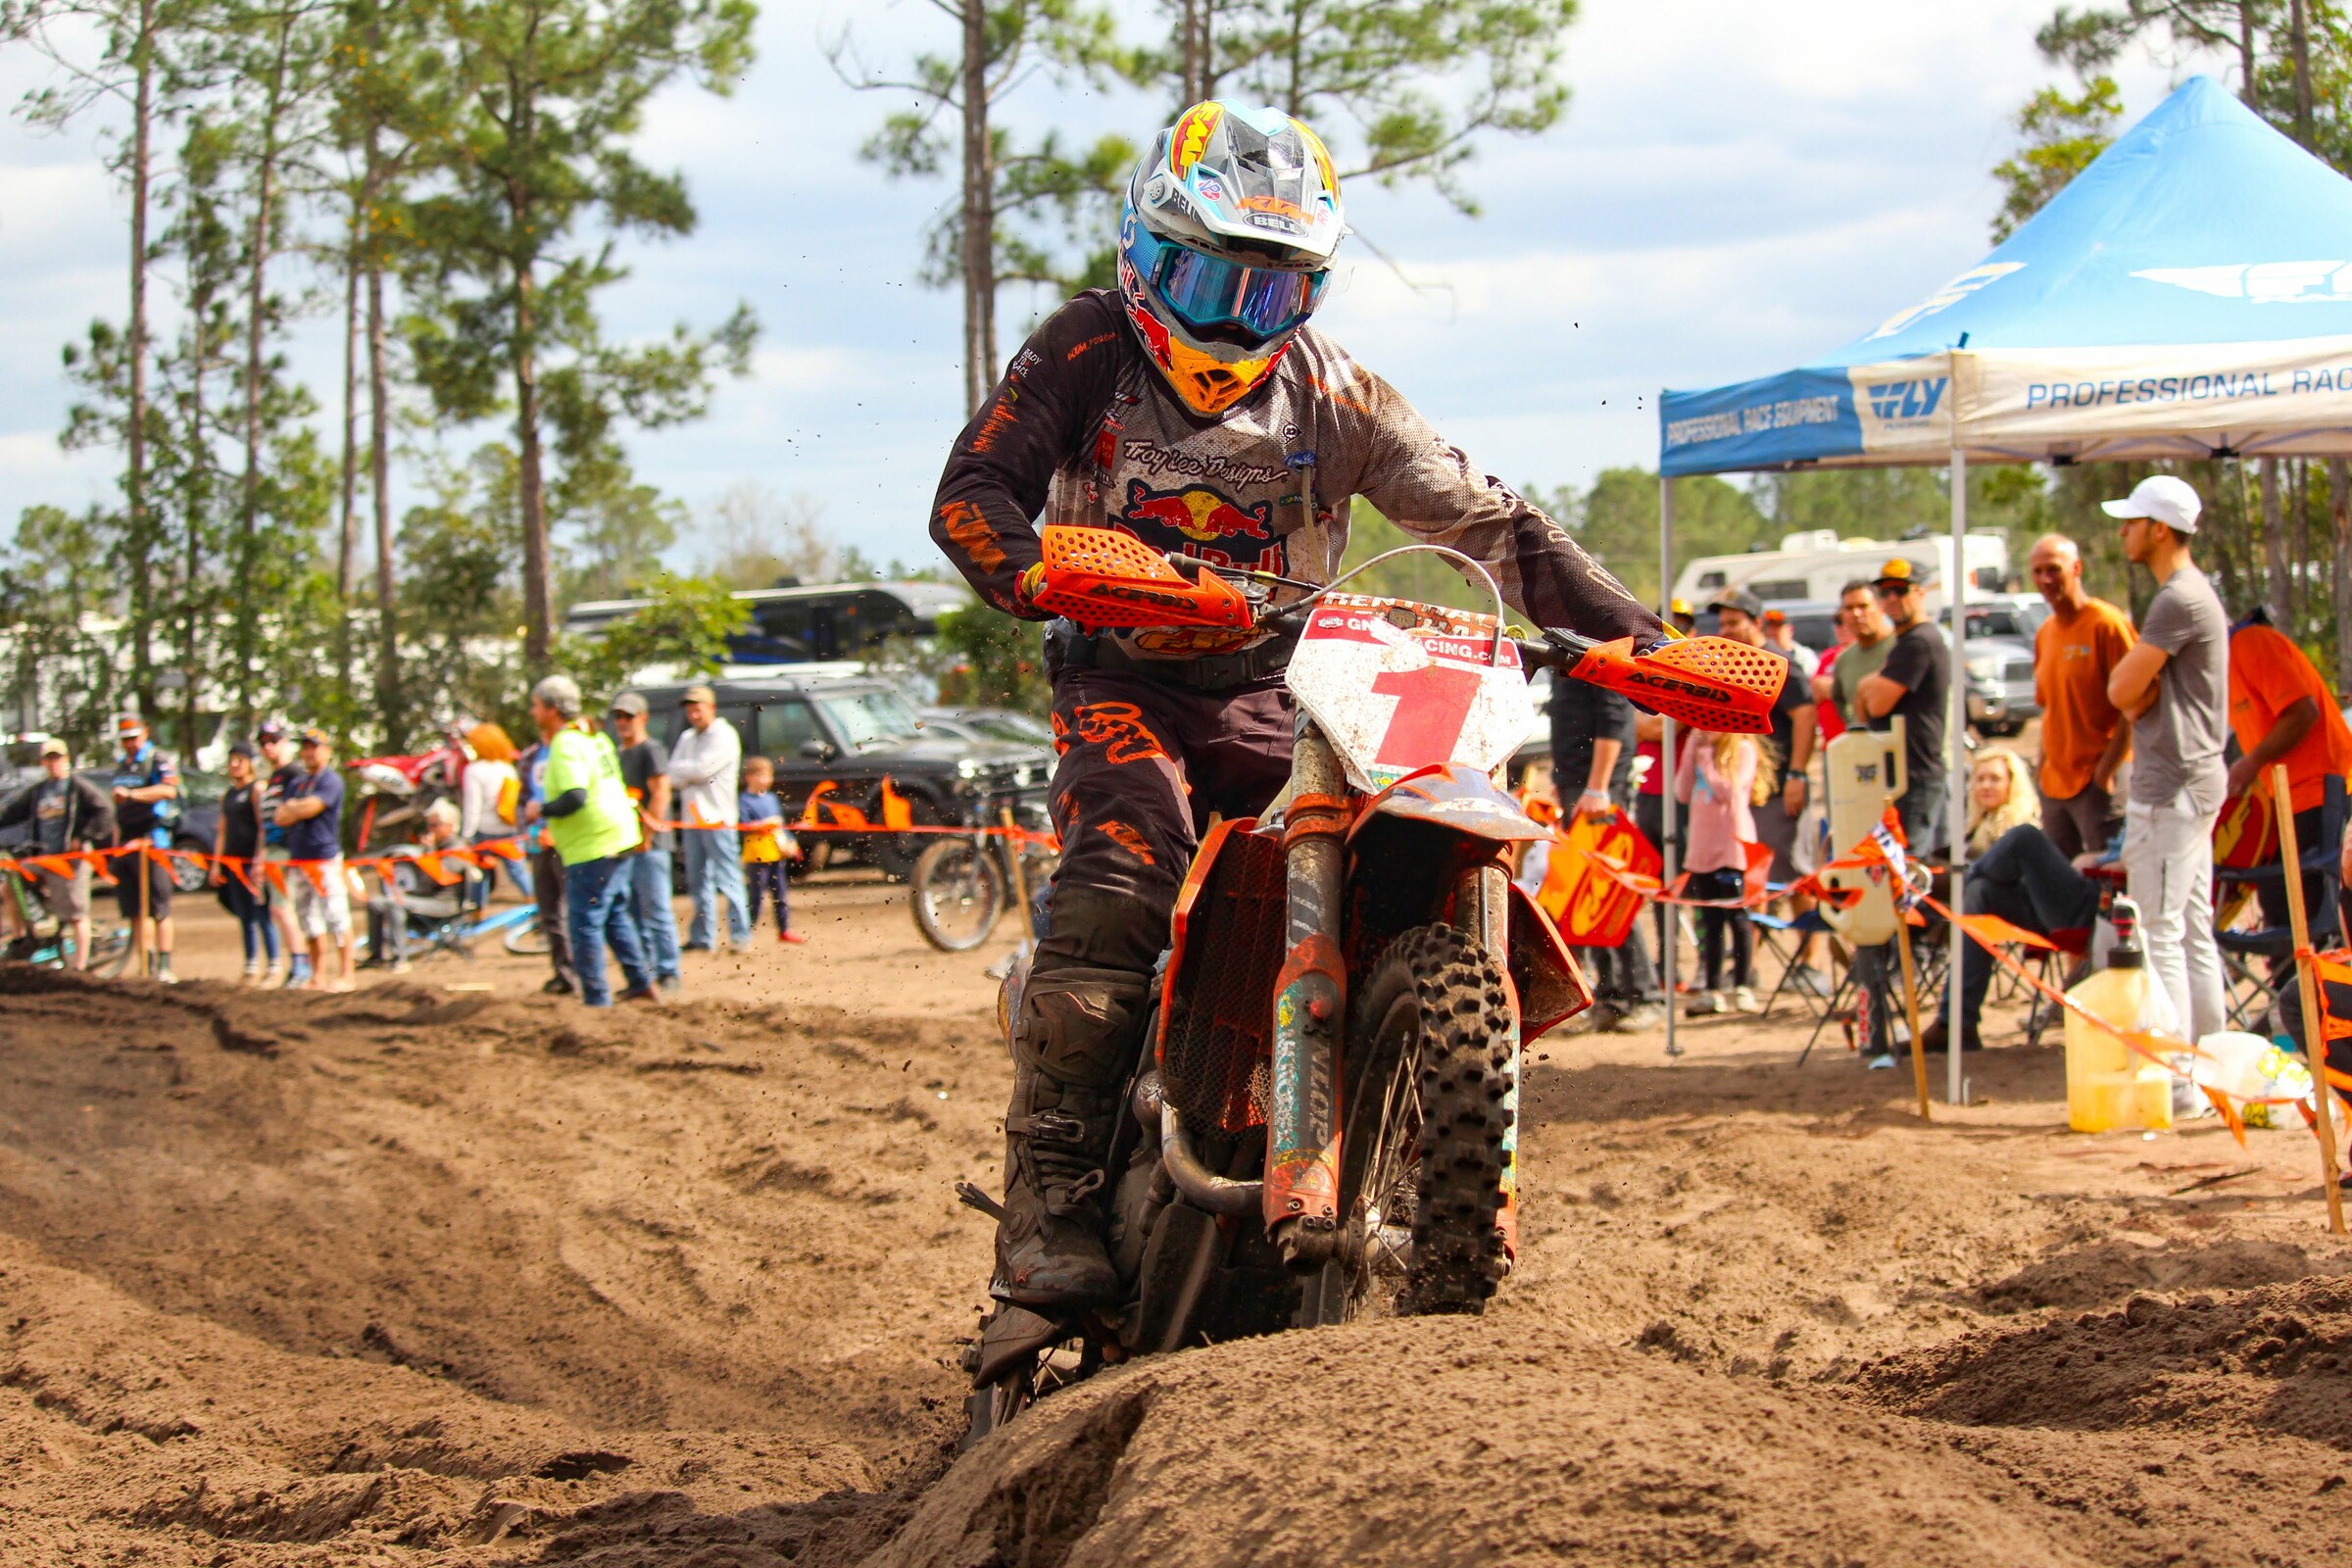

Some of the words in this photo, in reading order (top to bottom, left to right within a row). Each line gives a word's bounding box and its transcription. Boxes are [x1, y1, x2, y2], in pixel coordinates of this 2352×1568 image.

[1253, 216, 1300, 234] BELL
[1867, 376, 1947, 419] FLY
[2028, 372, 2278, 411] PROFESSIONAL
[1125, 441, 1169, 475] Troy
[1168, 449, 1202, 474] Lee
[1206, 455, 1289, 491] Designs
[1089, 582, 1199, 611] ACERBIS
[1625, 670, 1733, 704] ACERBIS
[1370, 663, 1483, 770] 1
